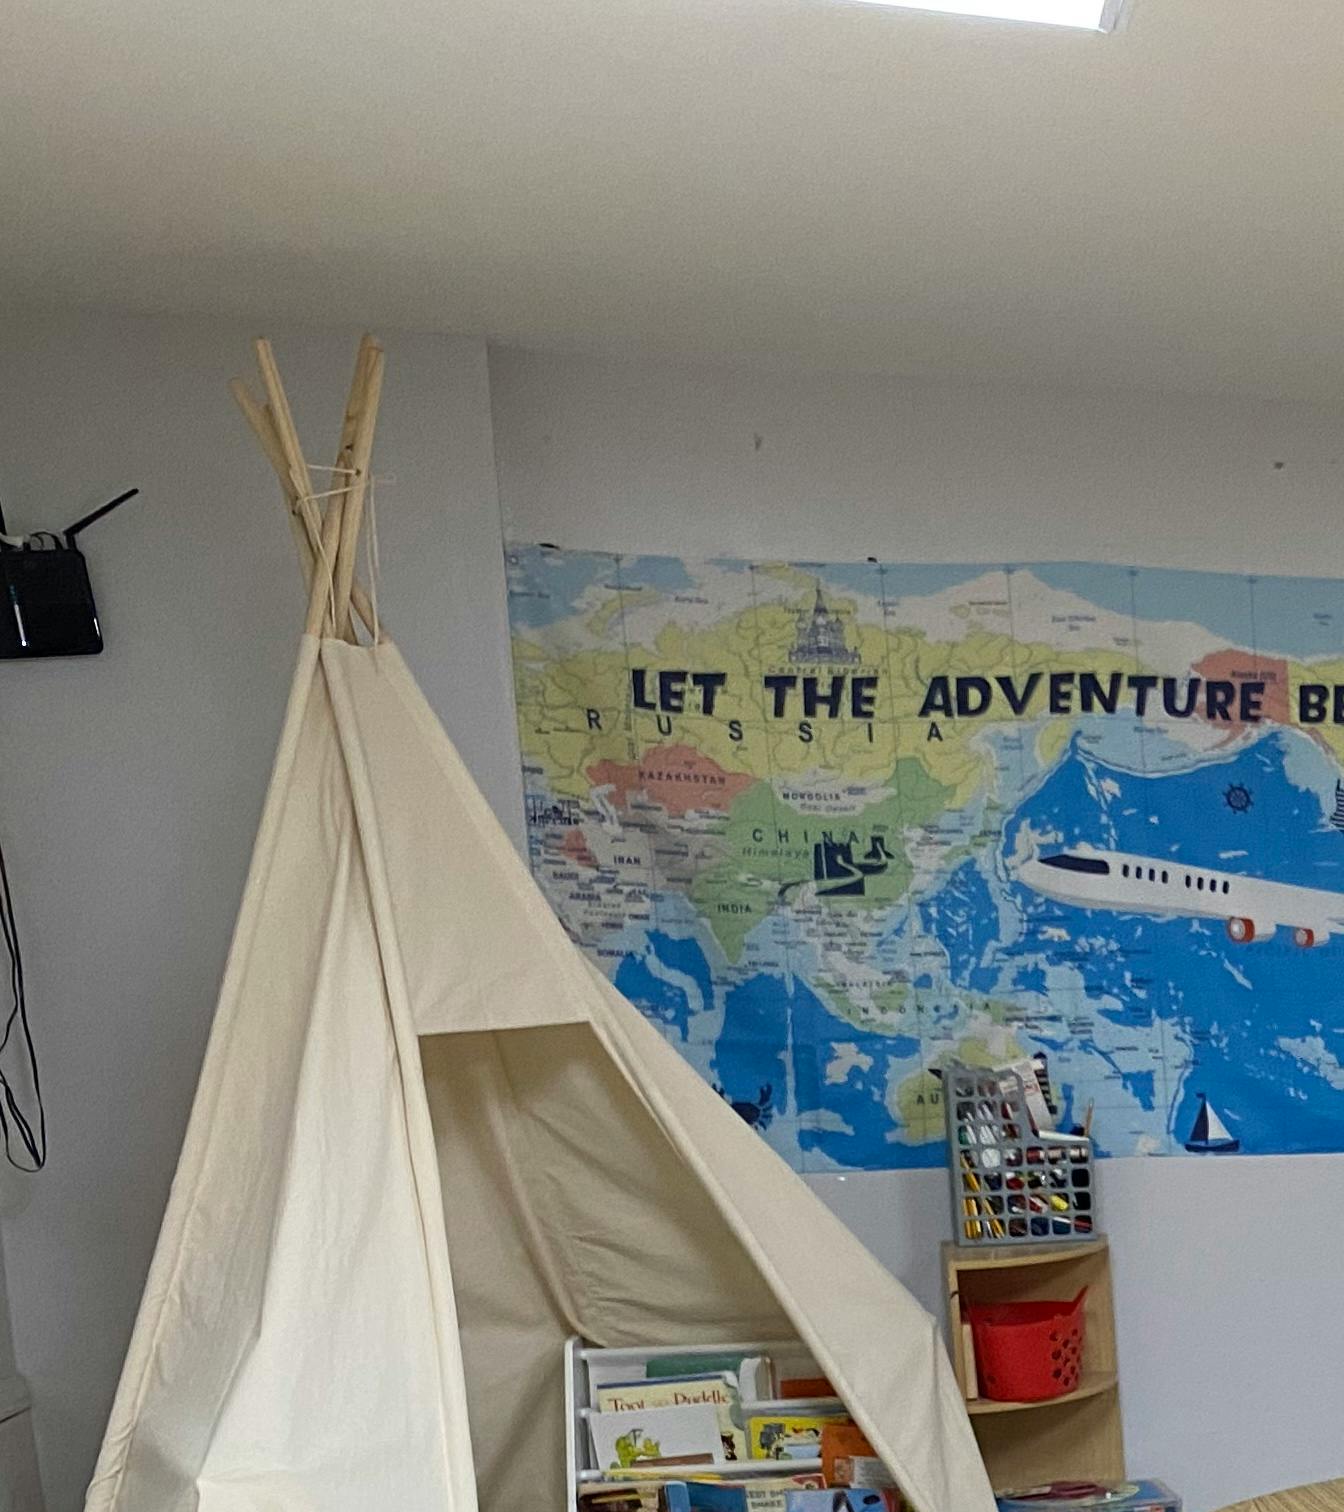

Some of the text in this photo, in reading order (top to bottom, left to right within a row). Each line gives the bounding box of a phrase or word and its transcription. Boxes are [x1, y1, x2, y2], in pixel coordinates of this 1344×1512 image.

[632, 668, 727, 716] LET
[763, 674, 879, 719] THE
[917, 670, 1266, 725] ADVENTURE
[585, 707, 944, 745] RUSSIA
[637, 770, 727, 786] KAZAKHSTAN
[752, 827, 860, 846] CHINA
[613, 856, 641, 866] IRAN
[716, 903, 752, 914] INDIA
